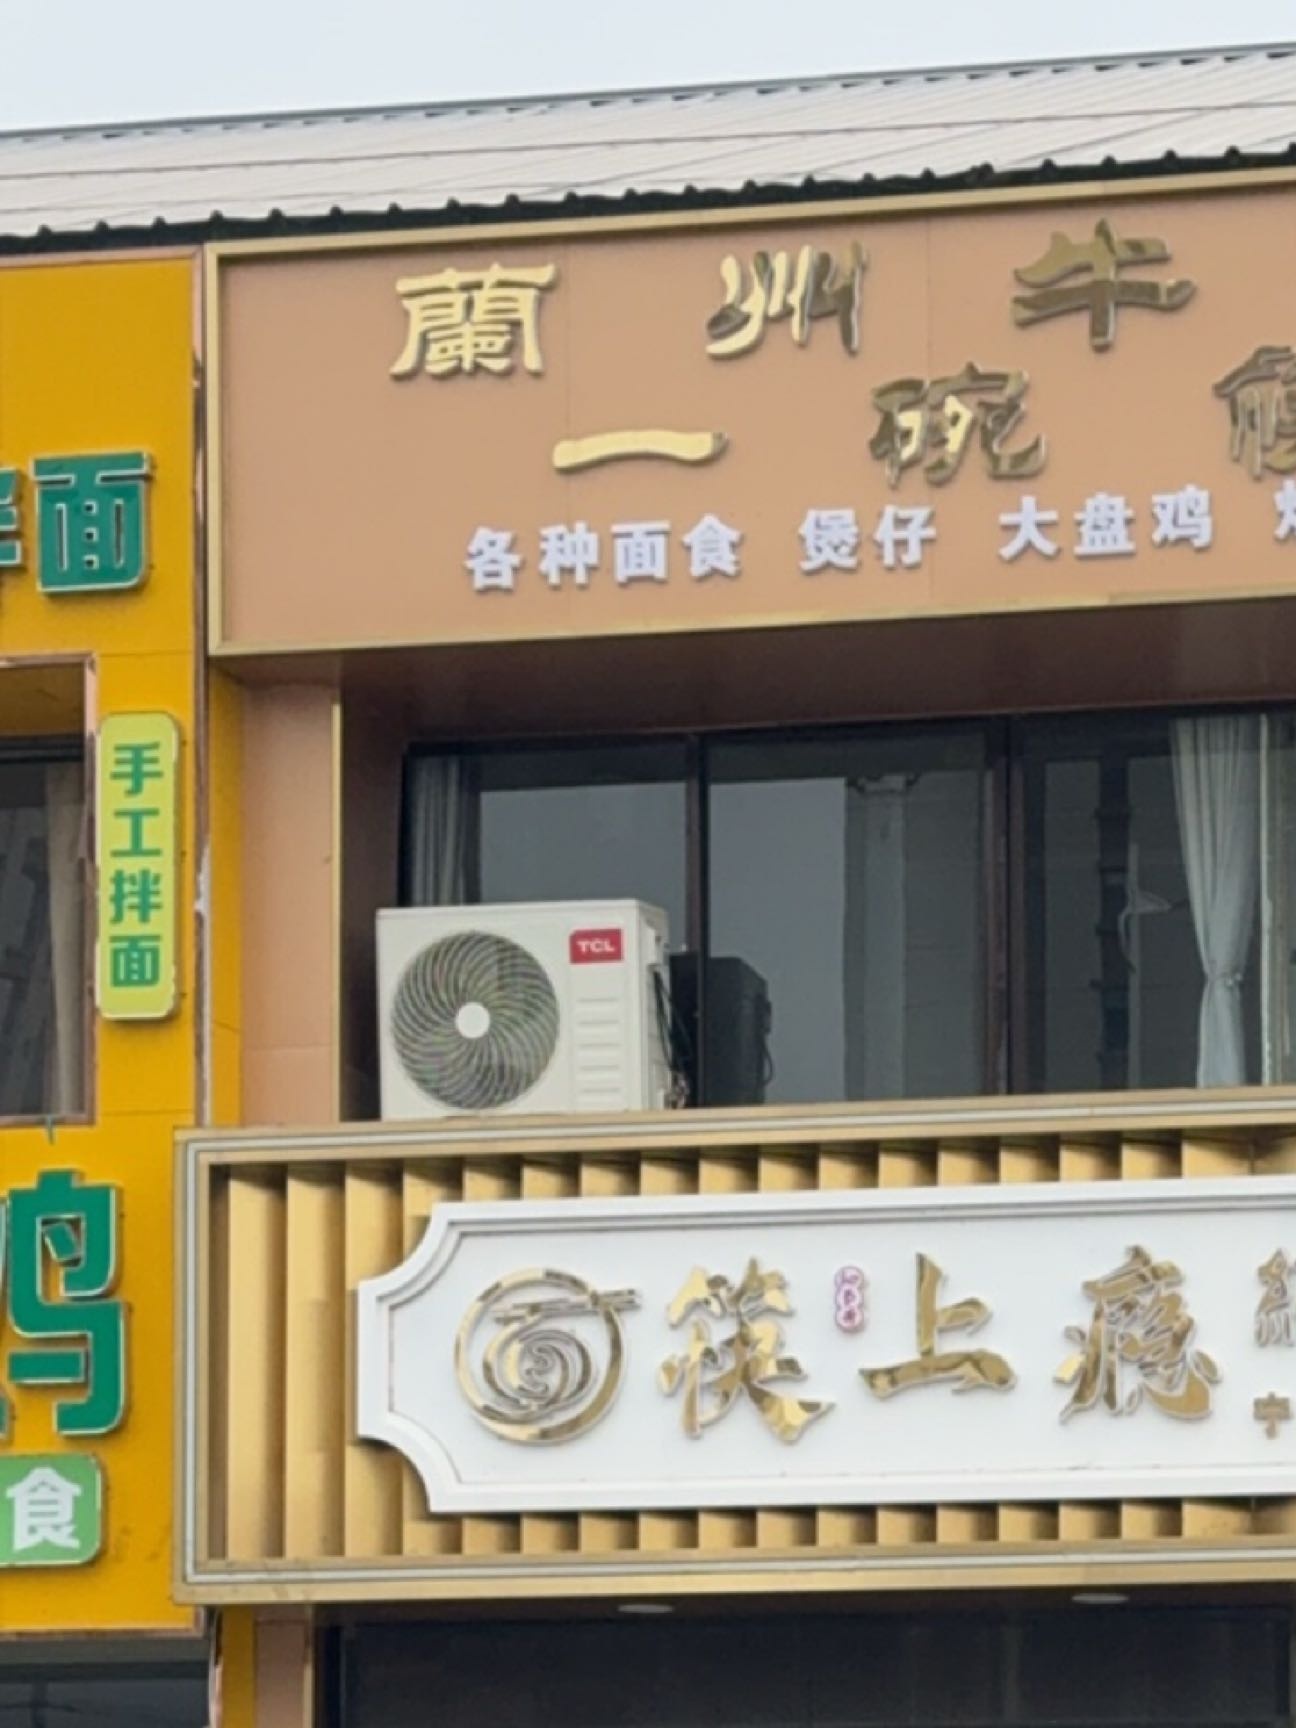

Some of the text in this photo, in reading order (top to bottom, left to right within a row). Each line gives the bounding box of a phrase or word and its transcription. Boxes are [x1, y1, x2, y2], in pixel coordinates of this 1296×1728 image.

[0, 451, 152, 594] 面
[464, 514, 742, 592] 各种面食
[798, 505, 937, 573] 煲仔
[999, 486, 1214, 562] 大盘鸡
[109, 741, 165, 989] 手工拌面
[576, 939, 616, 954] TCL
